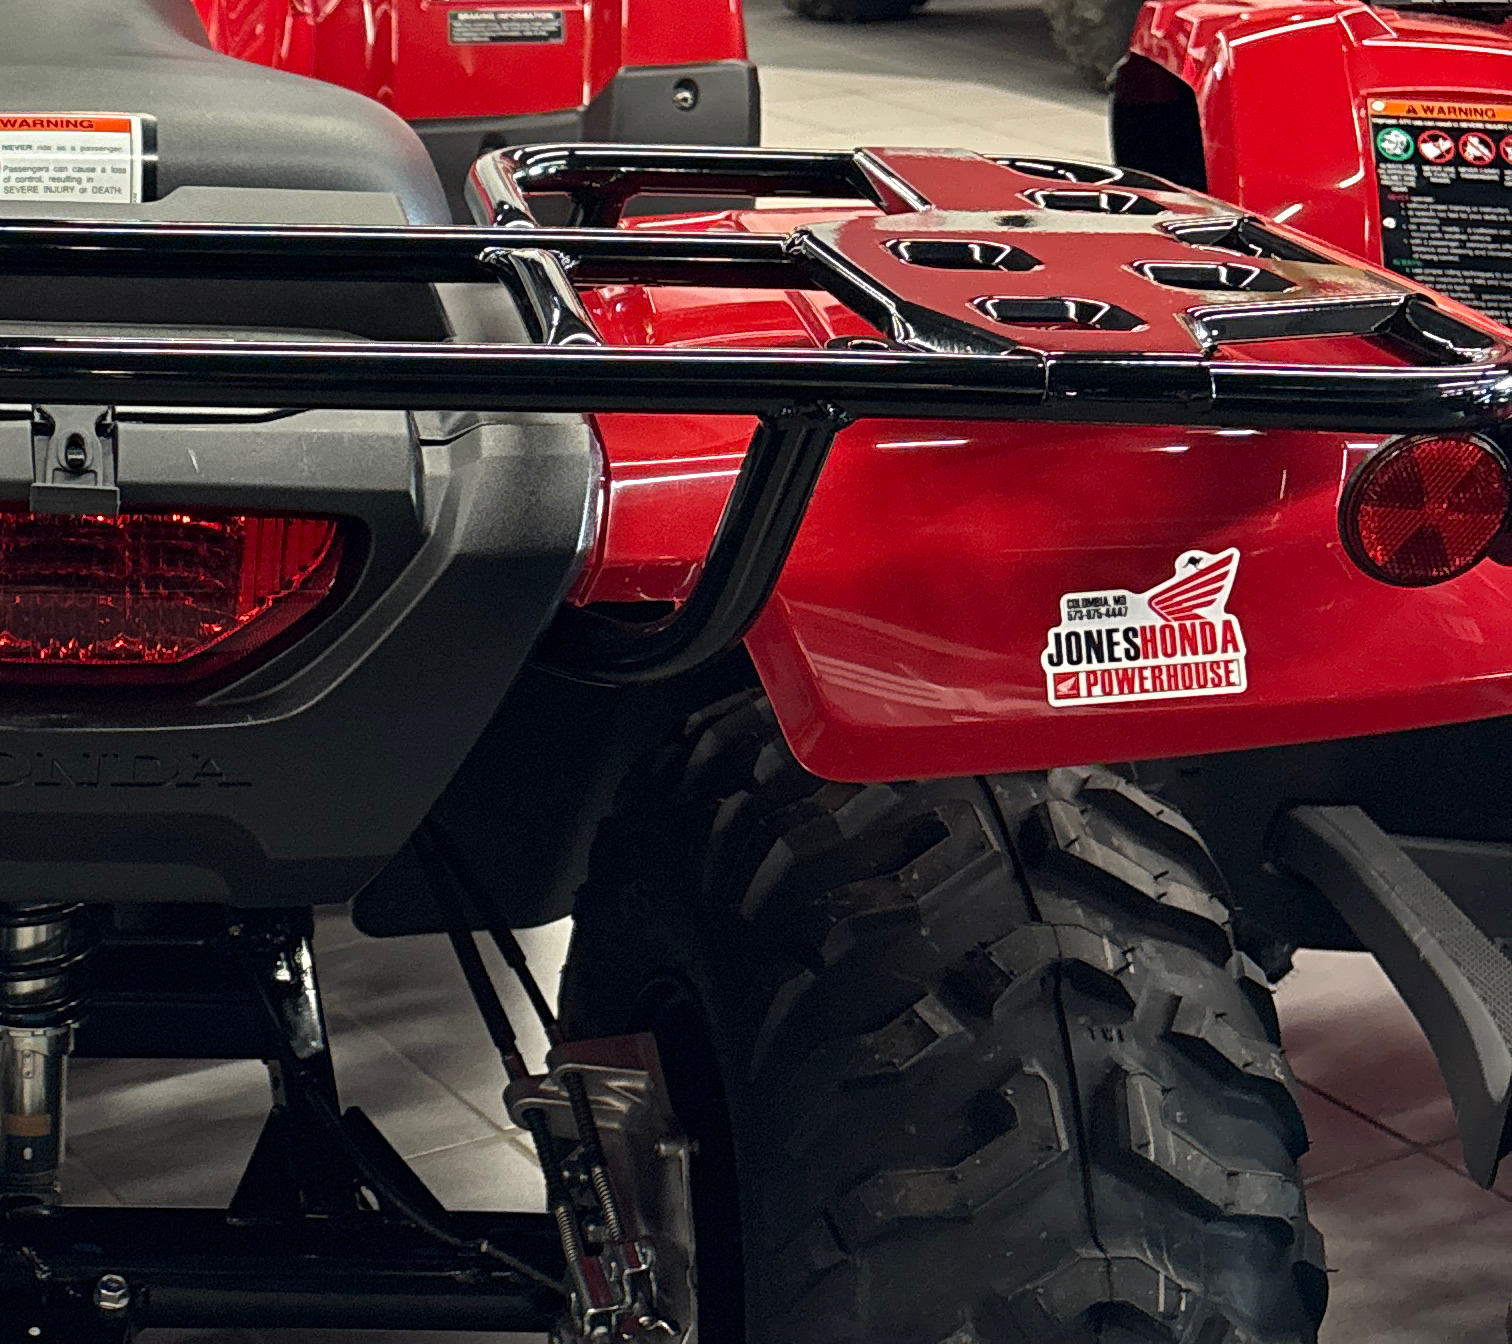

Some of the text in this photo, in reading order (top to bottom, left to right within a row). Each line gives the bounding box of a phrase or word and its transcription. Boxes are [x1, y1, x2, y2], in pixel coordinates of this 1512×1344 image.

[1420, 105, 1497, 119] WARNING
[0, 119, 93, 129] WARNING
[3, 165, 50, 175] Passengers
[111, 166, 127, 174] loss
[3, 175, 12, 183] of
[48, 176, 83, 185] resulting
[86, 176, 94, 184] in
[3, 186, 39, 194] SEVERE
[43, 186, 75, 194] INJURY
[1113, 595, 1126, 605] MO
[1087, 660, 1236, 697] POWERHOUSE
